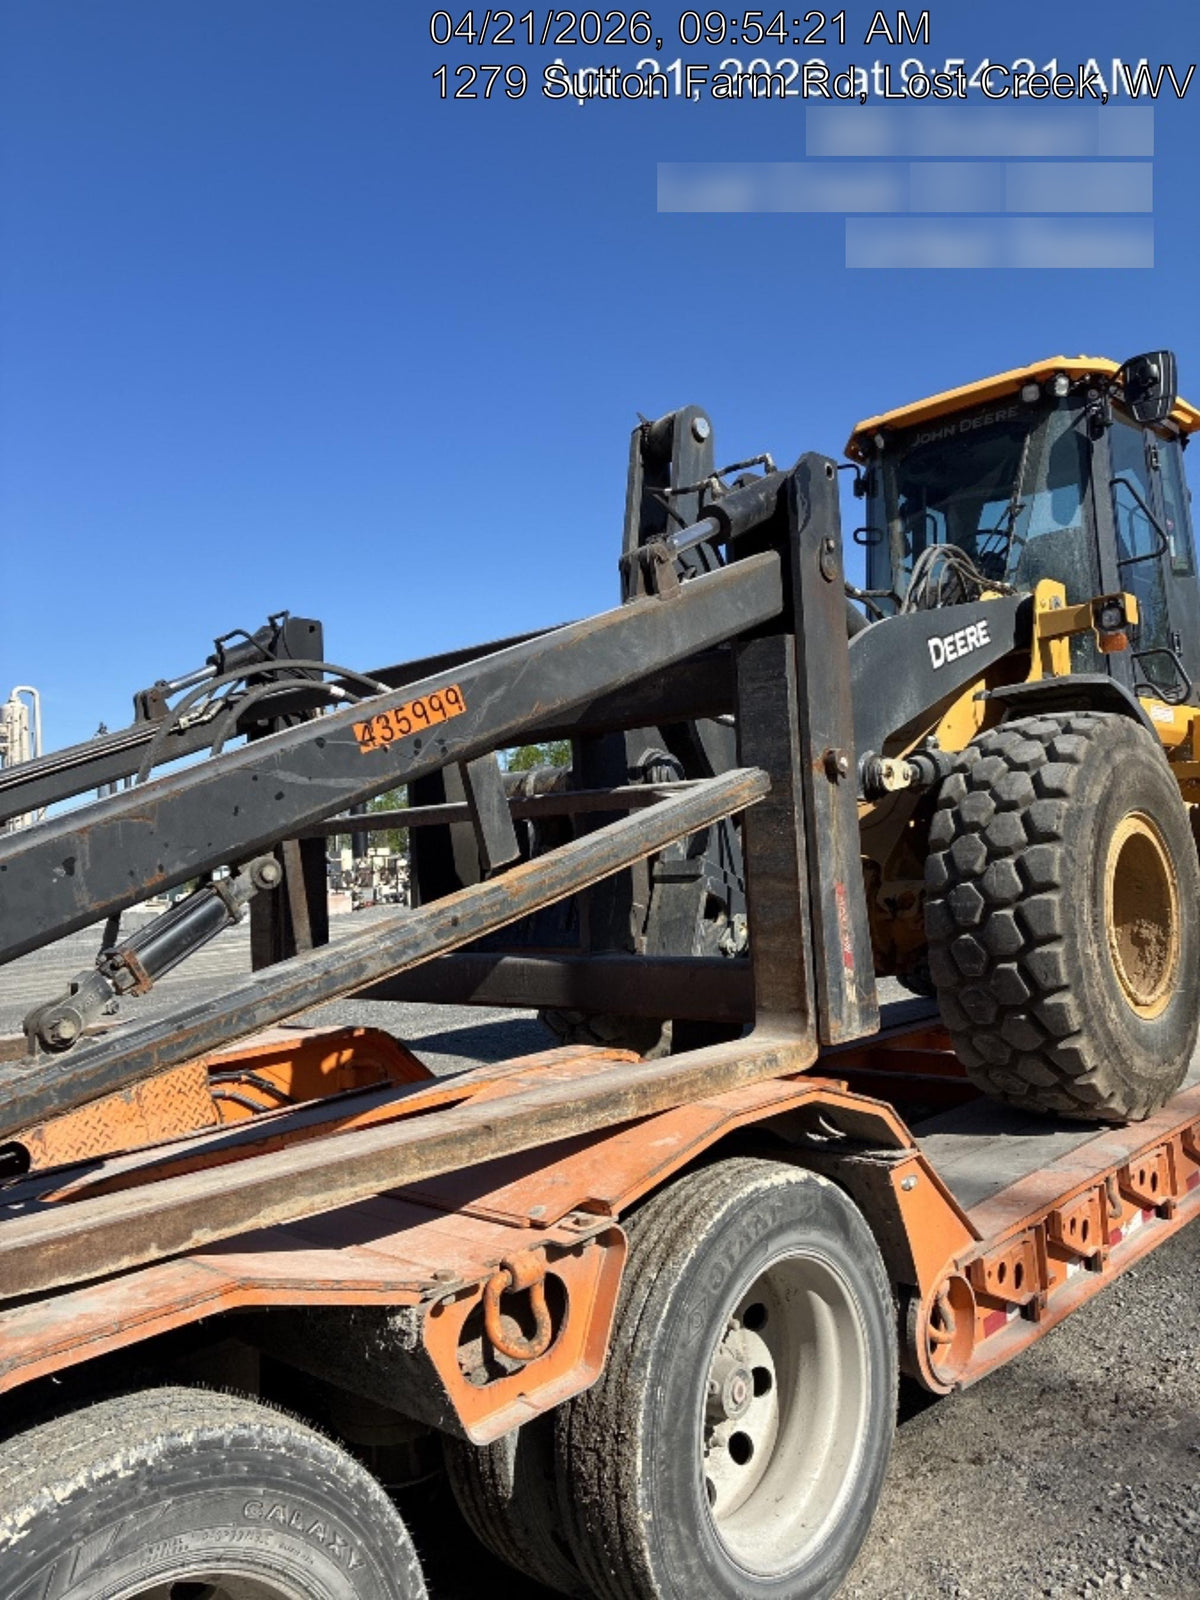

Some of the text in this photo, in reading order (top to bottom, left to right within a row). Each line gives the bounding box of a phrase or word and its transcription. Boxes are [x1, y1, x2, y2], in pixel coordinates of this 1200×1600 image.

[911, 404, 1019, 448] JOHN DEERE
[928, 619, 991, 669] DEERE
[360, 687, 463, 747] 435999
